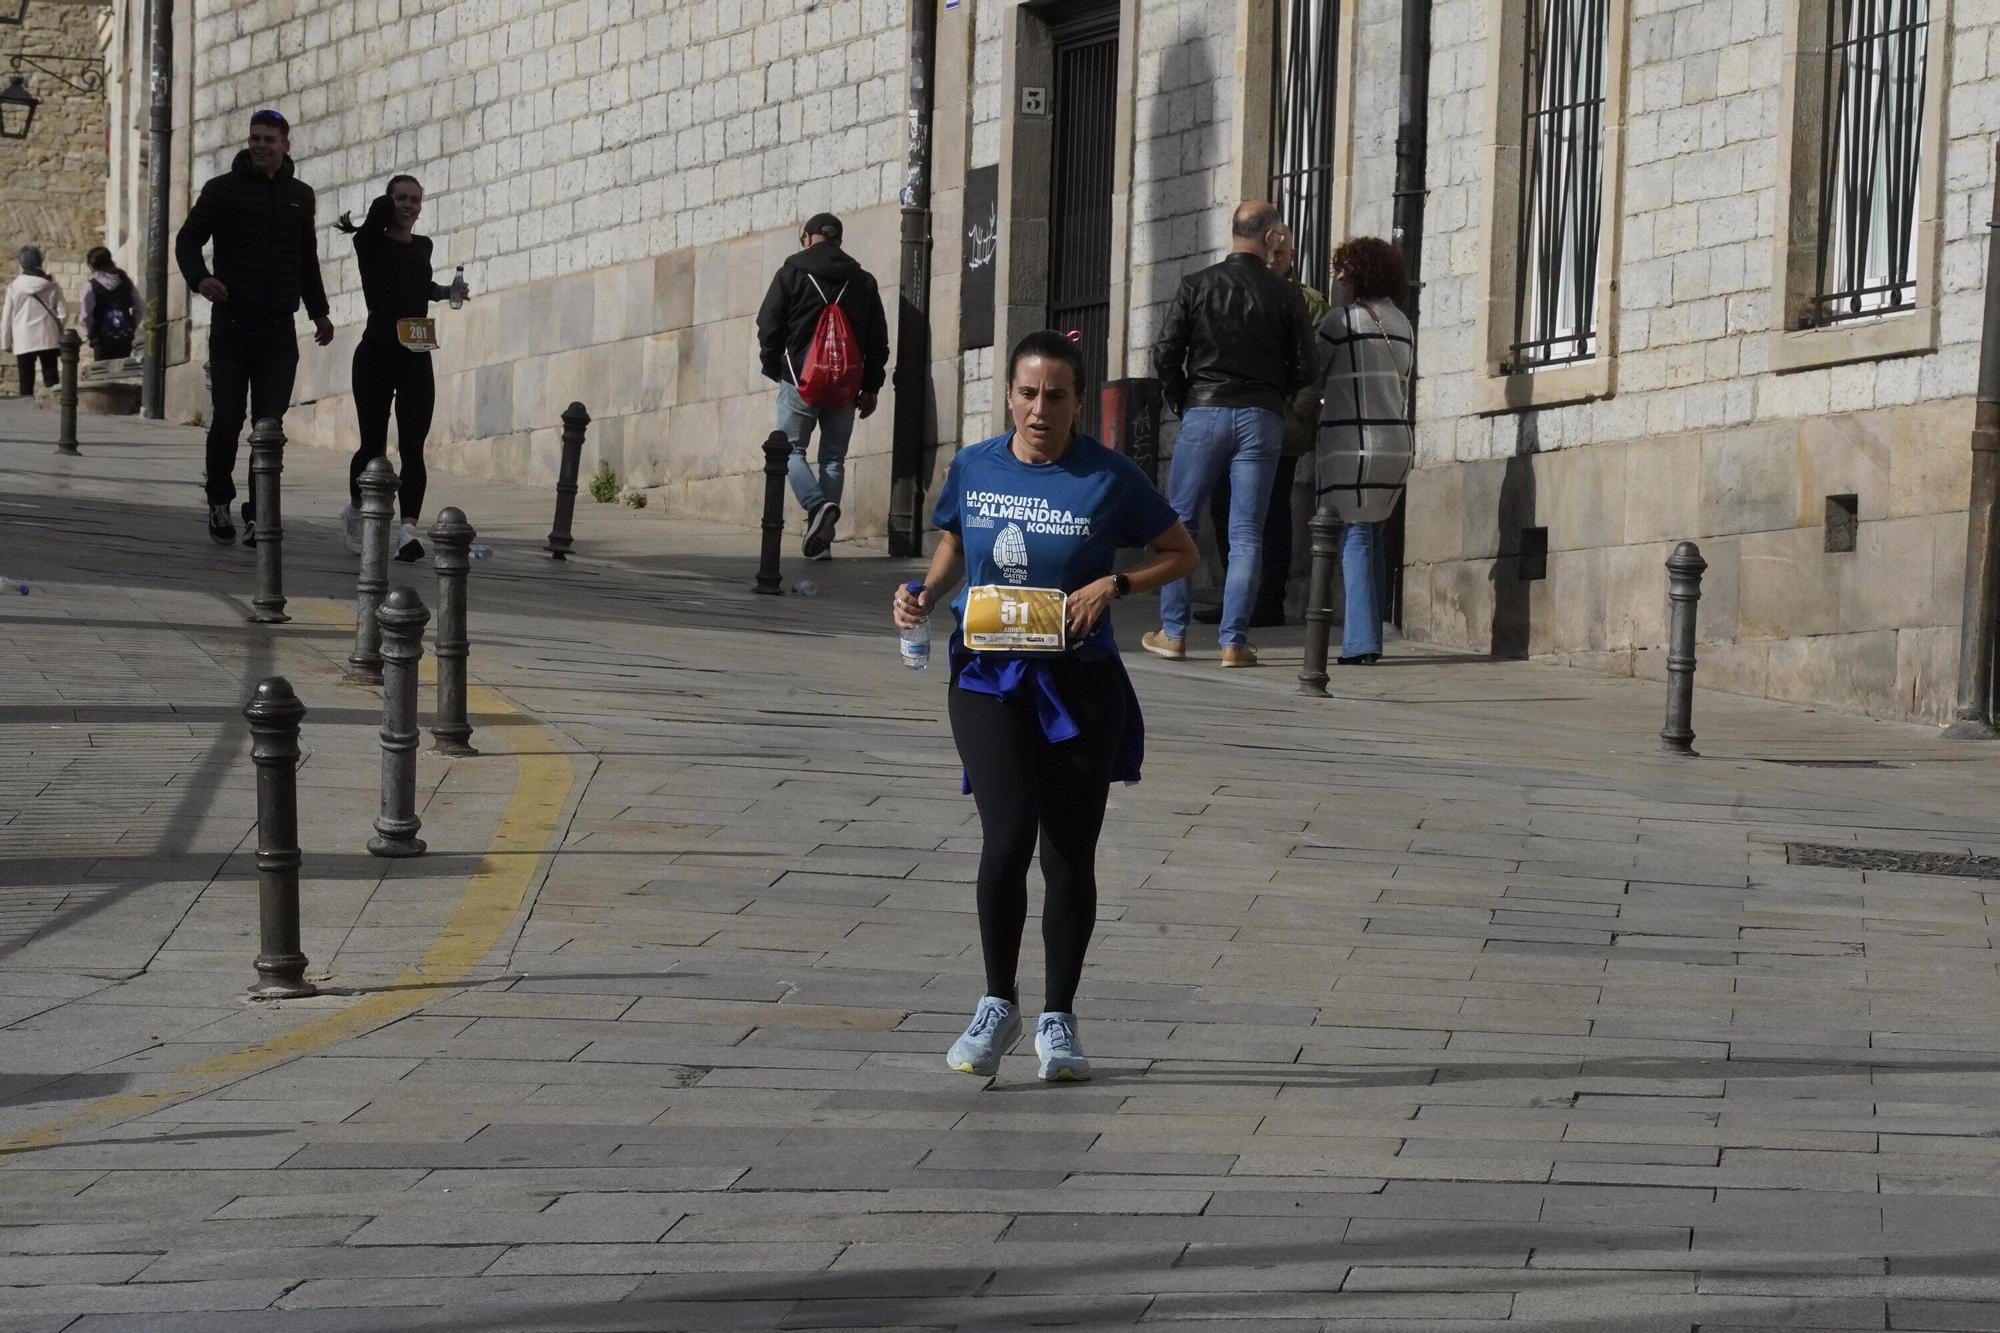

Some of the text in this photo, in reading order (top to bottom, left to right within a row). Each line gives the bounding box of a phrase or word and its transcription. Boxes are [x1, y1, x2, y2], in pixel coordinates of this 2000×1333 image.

[409, 326, 427, 339] 261
[967, 491, 1049, 509] LA CONQUISTA
[979, 503, 1073, 524] ALMENDRA
[1026, 522, 1091, 536] KONKISTA
[1001, 601, 1029, 625] 51
